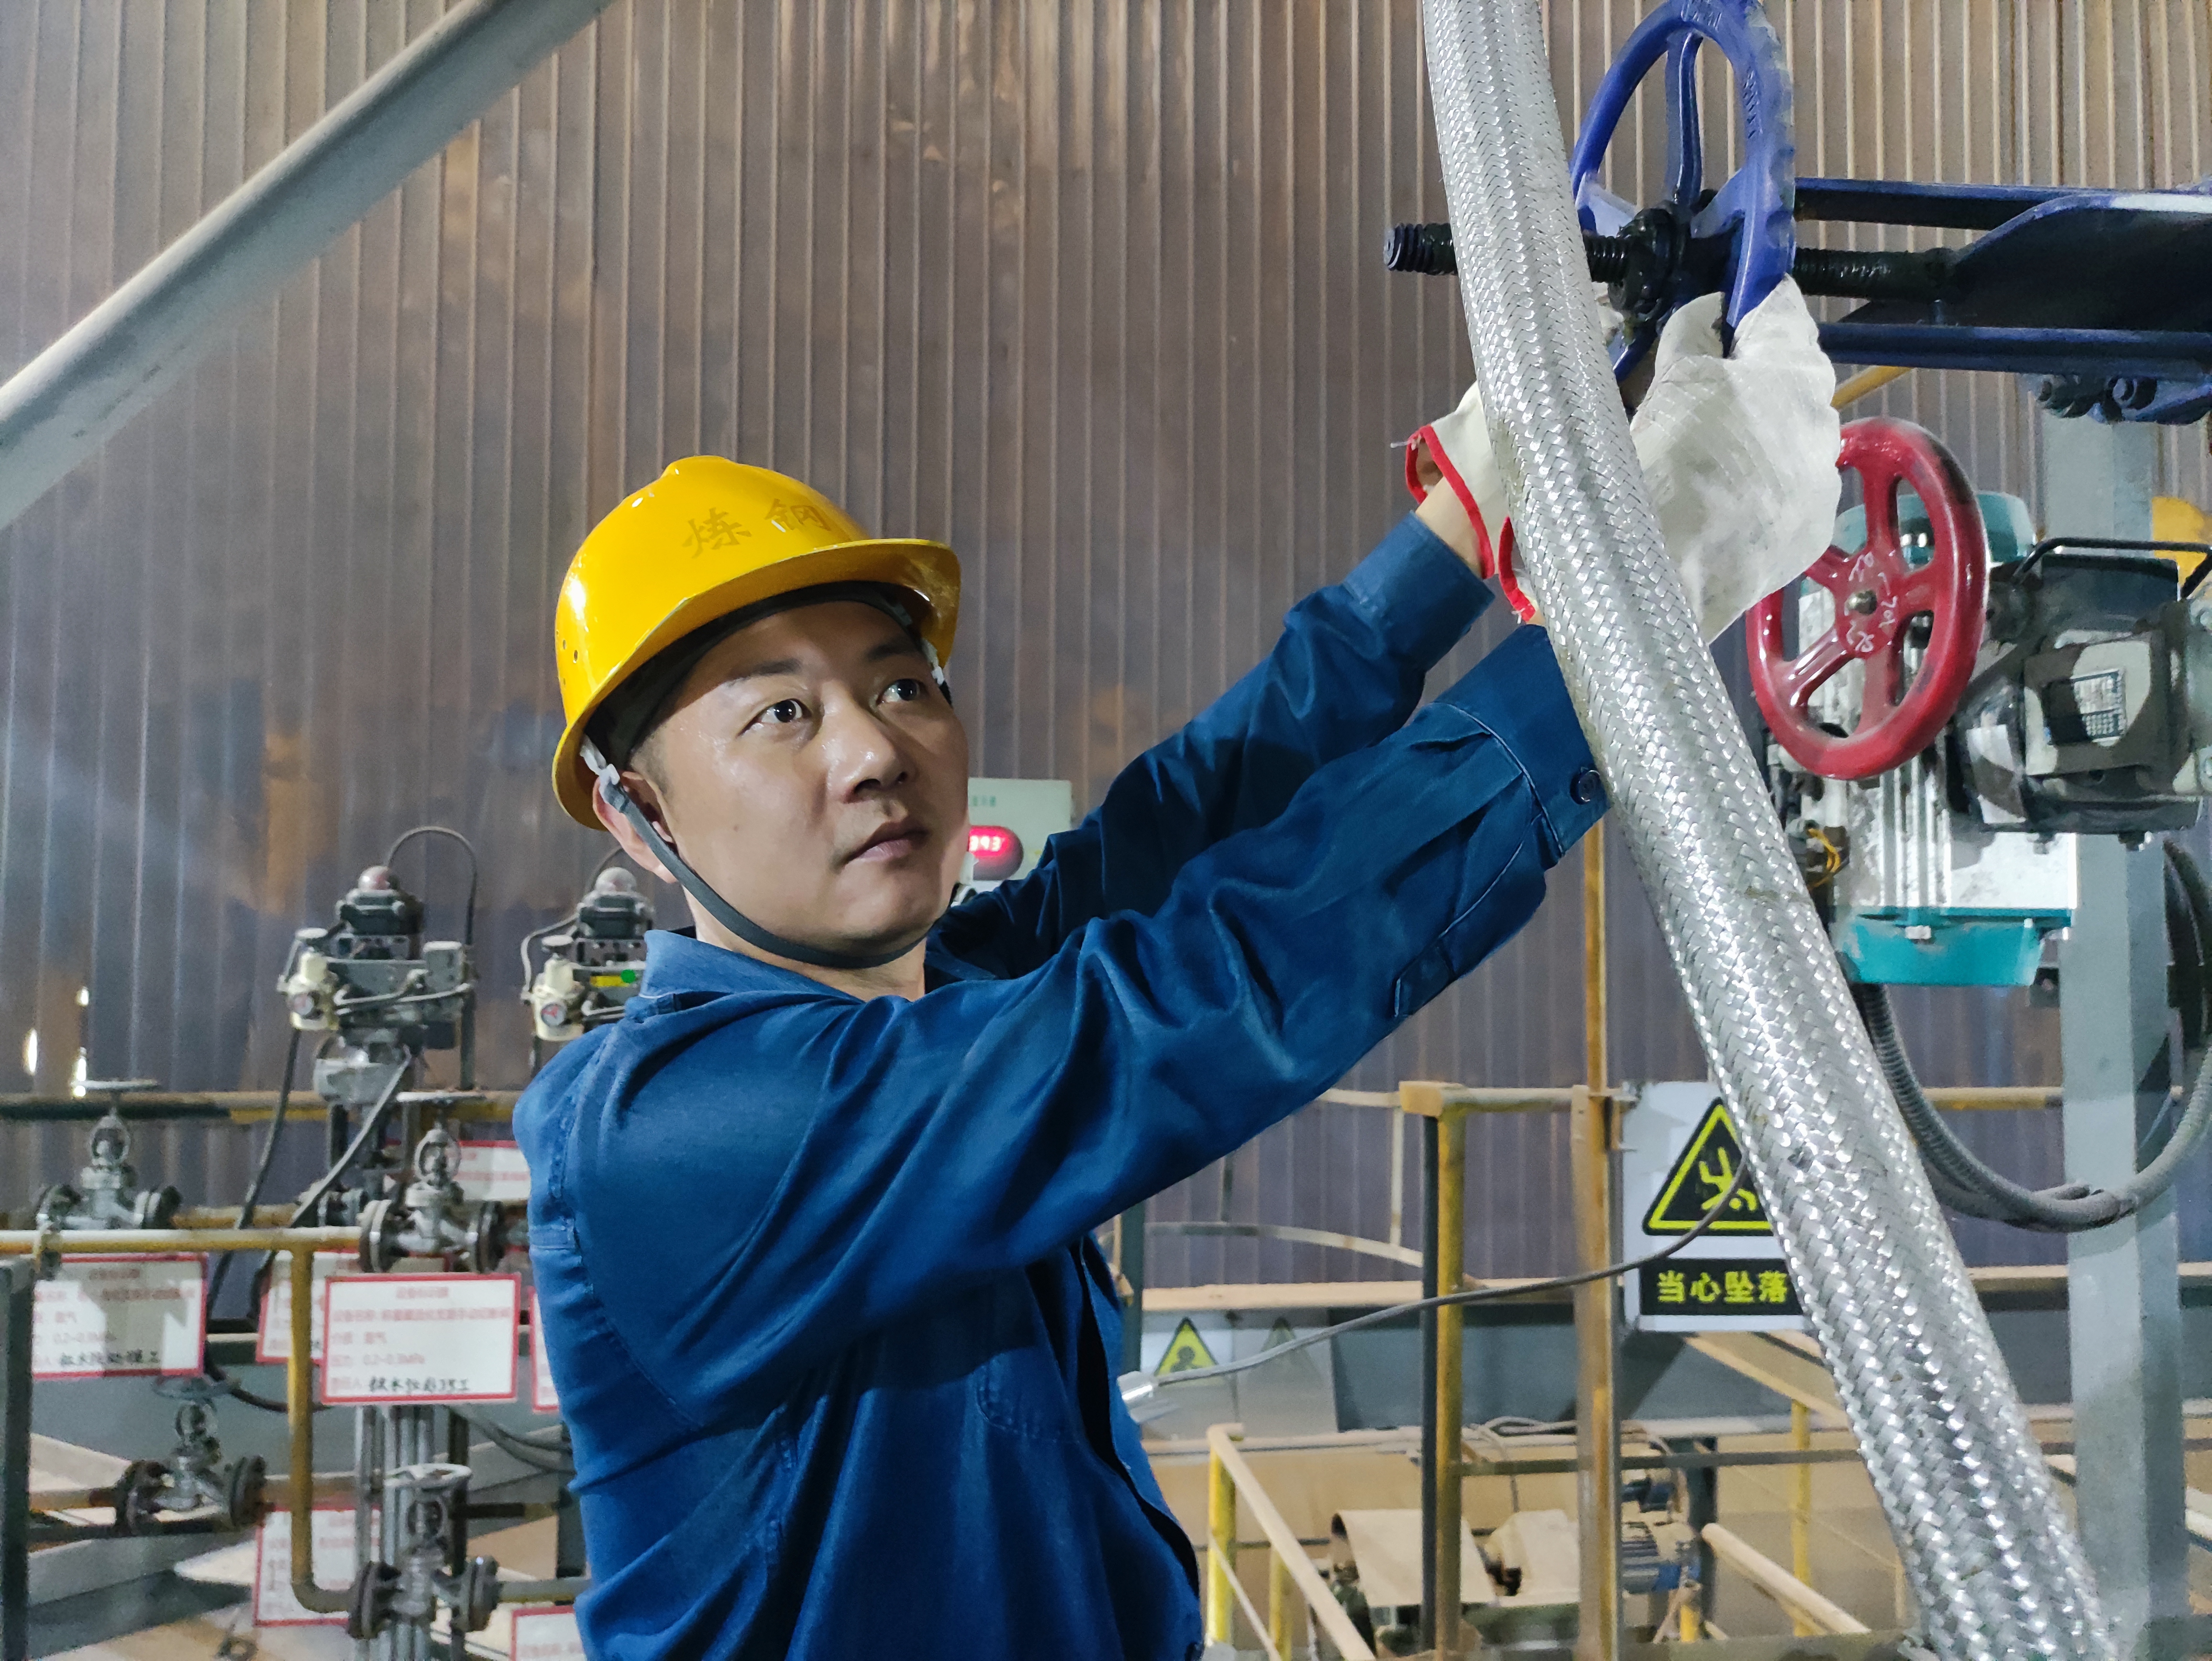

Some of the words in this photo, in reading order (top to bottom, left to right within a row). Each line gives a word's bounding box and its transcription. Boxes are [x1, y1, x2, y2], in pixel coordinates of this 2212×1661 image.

[682, 498, 832, 559] 炼钢
[1657, 1270, 1789, 1304] 当心坠落
